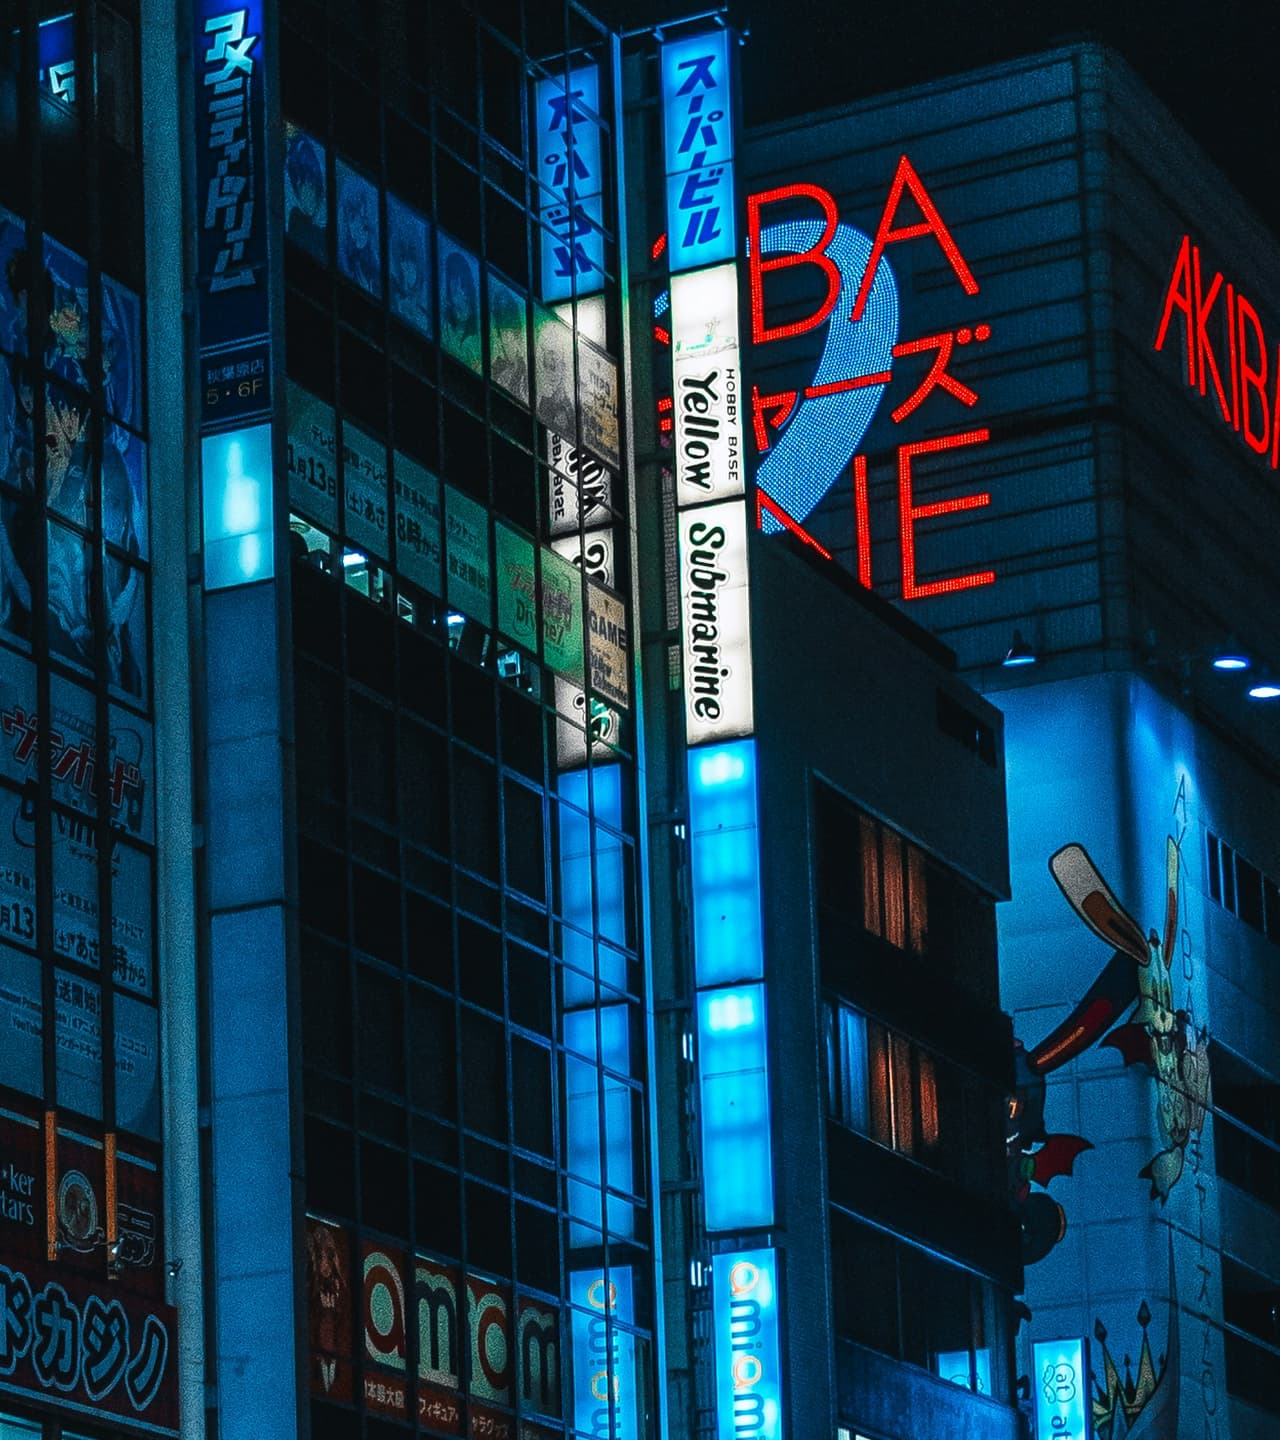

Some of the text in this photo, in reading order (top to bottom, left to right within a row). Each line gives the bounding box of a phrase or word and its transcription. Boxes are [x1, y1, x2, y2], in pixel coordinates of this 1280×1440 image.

[676, 53, 722, 247] スーパービル
[725, 368, 739, 481] HOBBY BASE
[678, 370, 728, 723] Yellow Submarine
